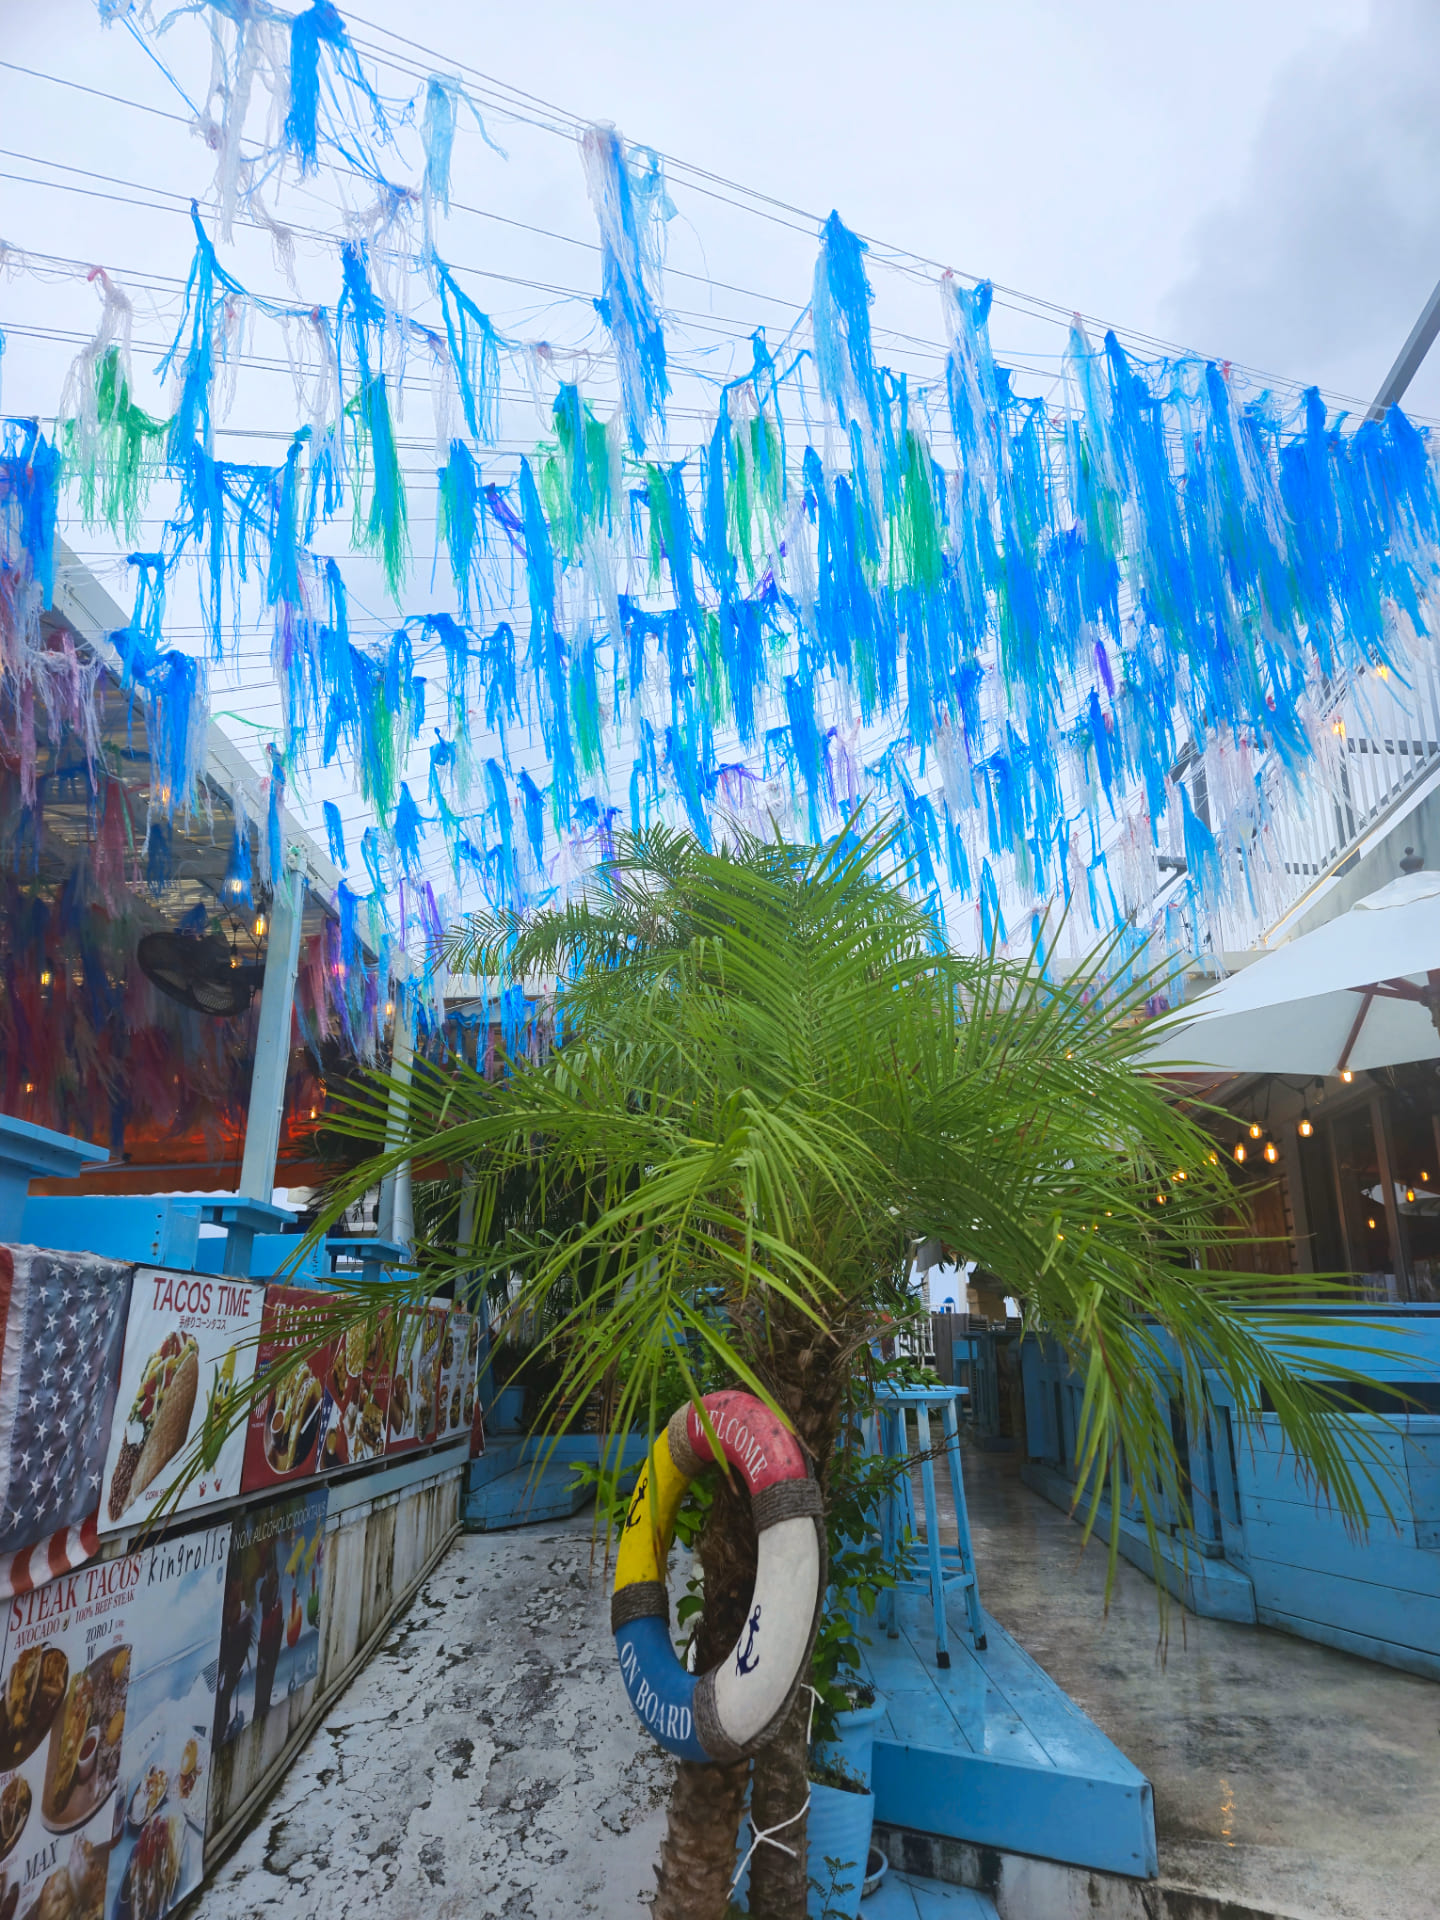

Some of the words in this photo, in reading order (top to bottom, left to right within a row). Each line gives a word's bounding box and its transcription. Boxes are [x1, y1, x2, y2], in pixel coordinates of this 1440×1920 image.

[153, 1277, 212, 1314] TACOS
[217, 1285, 252, 1317] TIME
[178, 1316, 226, 1330] 手作りコーンタコス
[694, 1410, 768, 1483] WELCOME
[231, 1525, 253, 1551] NON
[253, 1512, 295, 1544] ALCOHOLIC
[294, 1501, 328, 1527] COCKTAILS
[147, 1529, 225, 1586] kingrolls
[10, 1575, 80, 1632] STEAK
[85, 1553, 142, 1603] TACOS
[14, 1617, 60, 1650] AVOCADO
[75, 1604, 94, 1624] 100%
[94, 1595, 113, 1616] BEEF
[112, 1588, 136, 1609] STEAK
[620, 1641, 641, 1689] ON
[635, 1677, 692, 1740] BOARD
[23, 1837, 60, 1887] MAX
